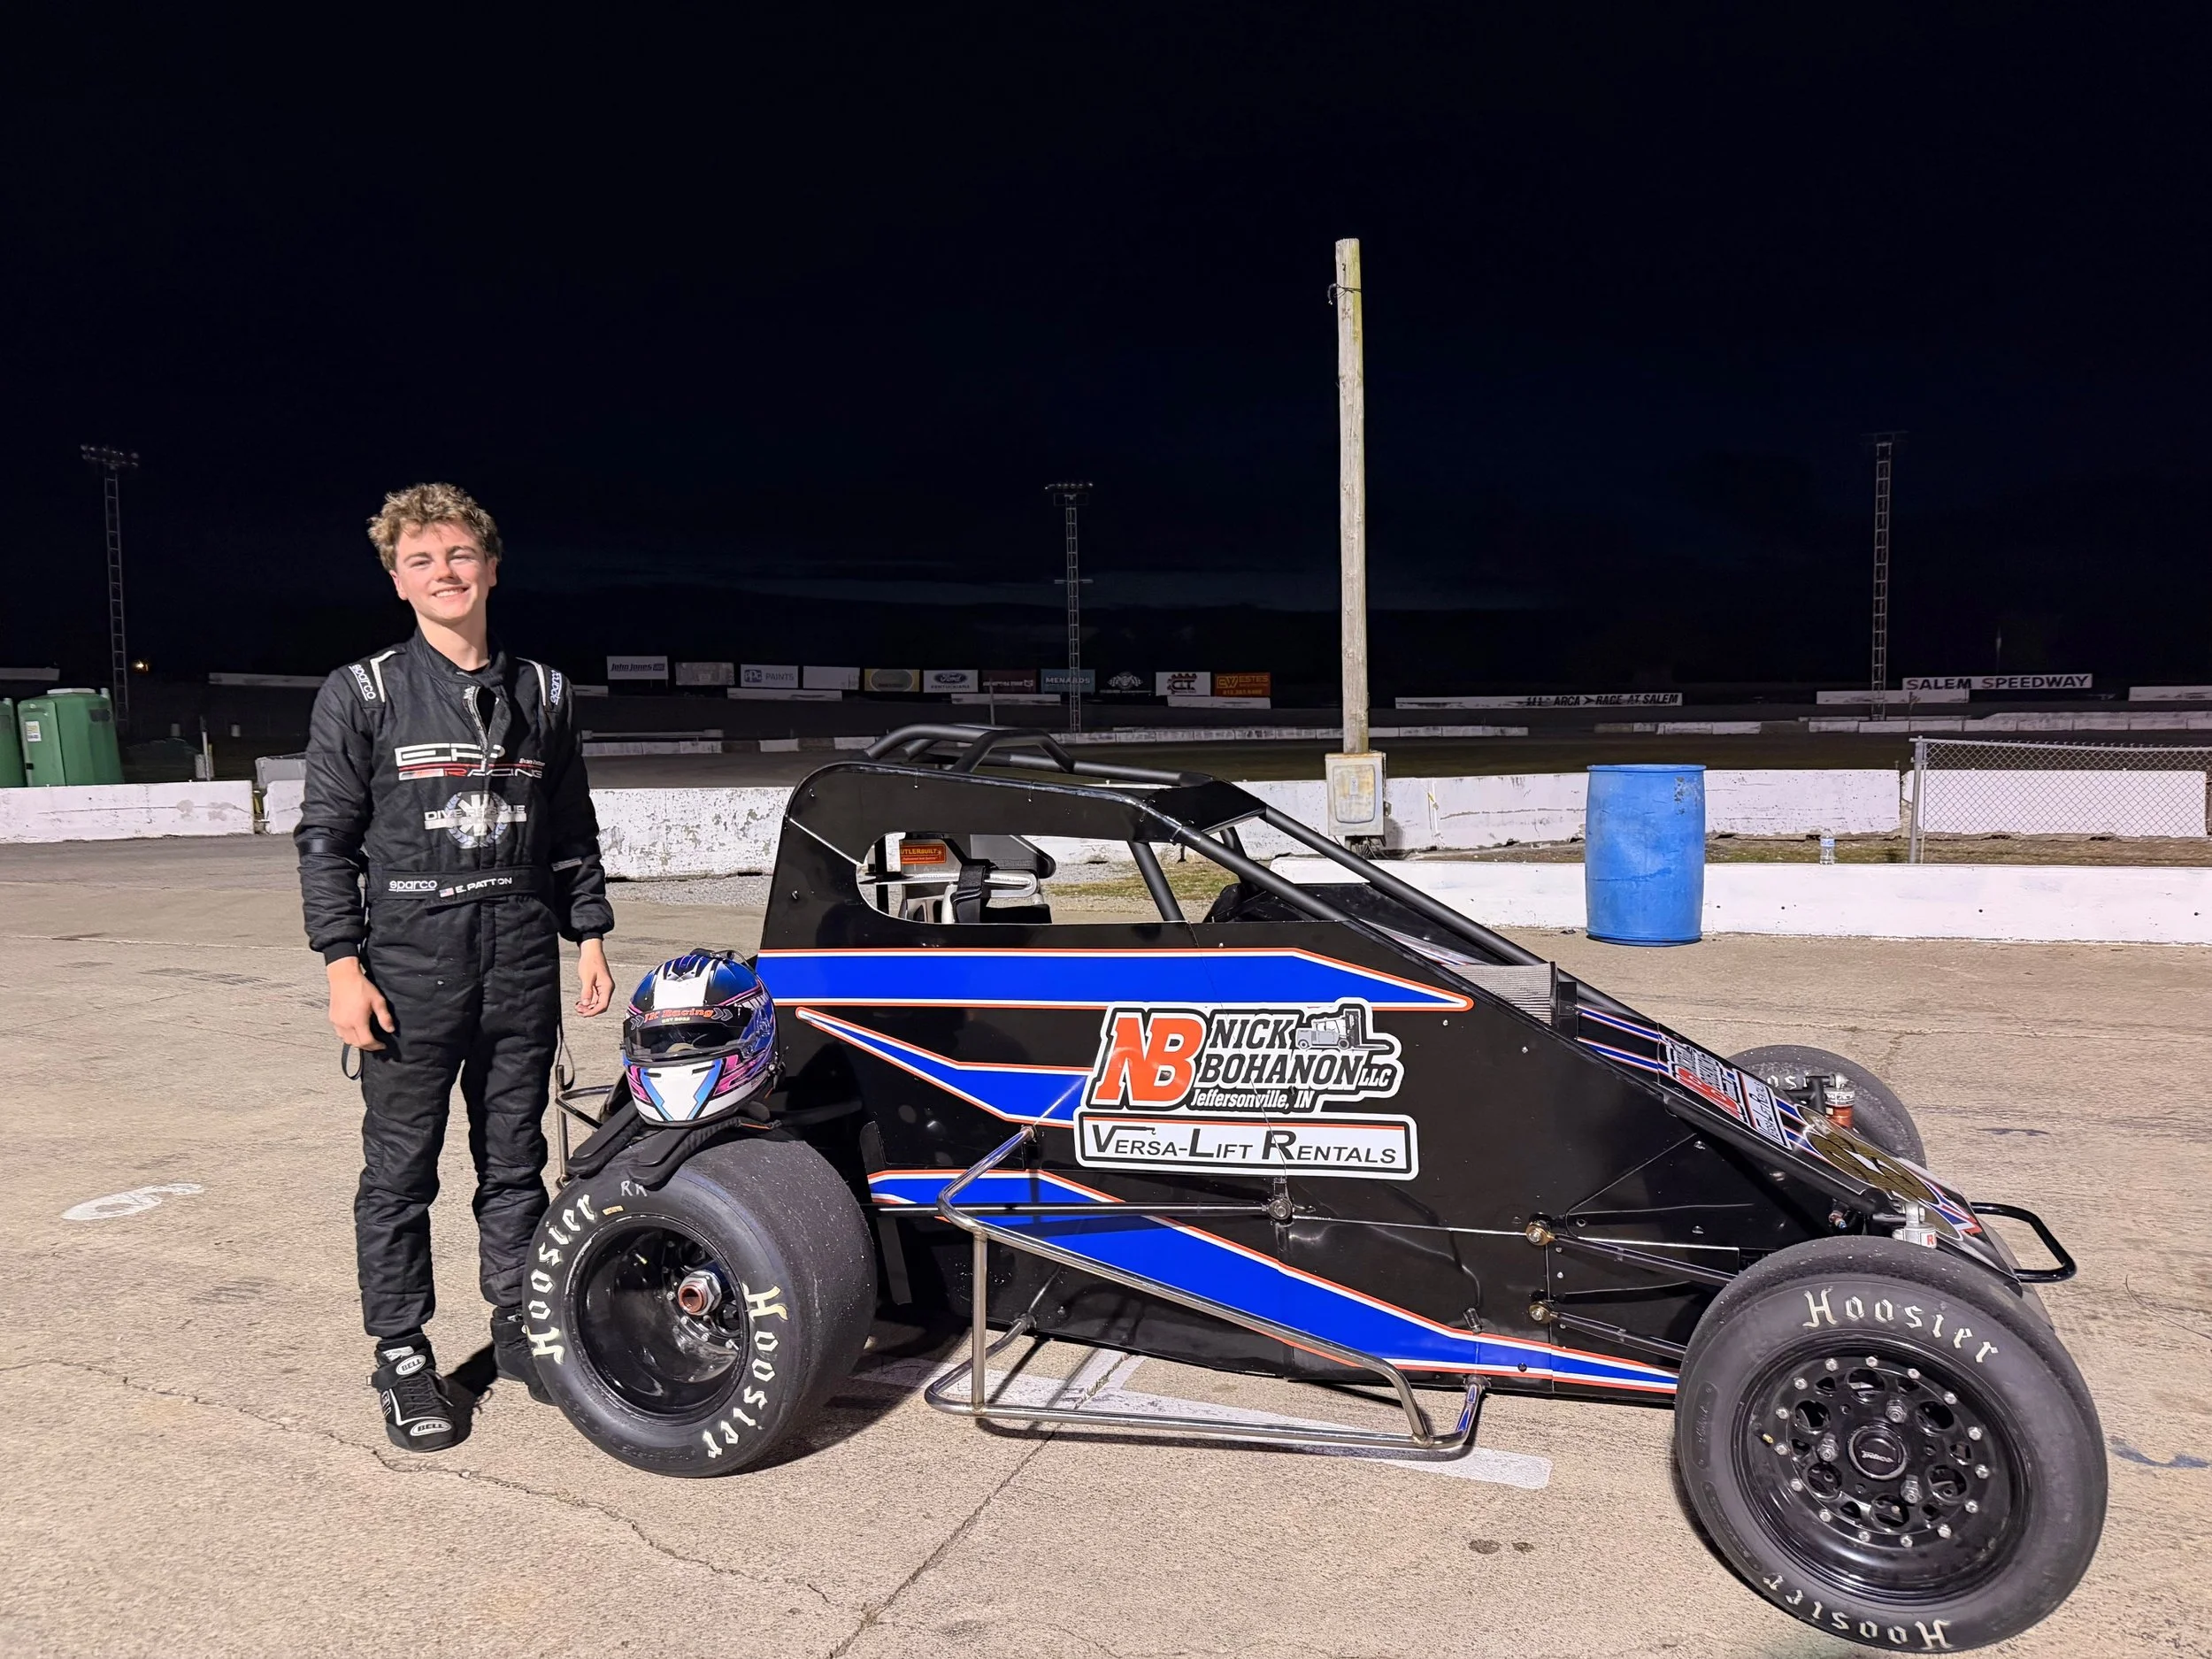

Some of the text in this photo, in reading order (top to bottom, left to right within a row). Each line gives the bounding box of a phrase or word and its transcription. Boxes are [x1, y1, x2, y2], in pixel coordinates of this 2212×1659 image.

[349, 663, 376, 701] sparco
[765, 672, 795, 681] PAINTS
[1906, 674, 2091, 690] SALEM SPEEDWAY
[1554, 695, 1581, 706] ARCA
[1594, 695, 1624, 705] RACE
[1627, 695, 1641, 704] AT
[1642, 694, 1679, 704] SALEM
[389, 879, 438, 892] sparco
[466, 877, 513, 891] PATTON
[662, 1009, 714, 1018] Racing
[1209, 1017, 1298, 1049] NICK
[1094, 1015, 1204, 1103] NB
[1197, 1054, 1392, 1087] BOHANON LLC
[1190, 1088, 1315, 1110] Jeffersonville, IN
[1926, 1235, 1935, 1246] R
[526, 1193, 600, 1365] Hoosier
[1801, 1286, 2000, 1364] Hoosier
[402, 1359, 421, 1371] BELL
[702, 1281, 789, 1459] Hoosier
[1763, 1572, 1954, 1651] Hoosier
